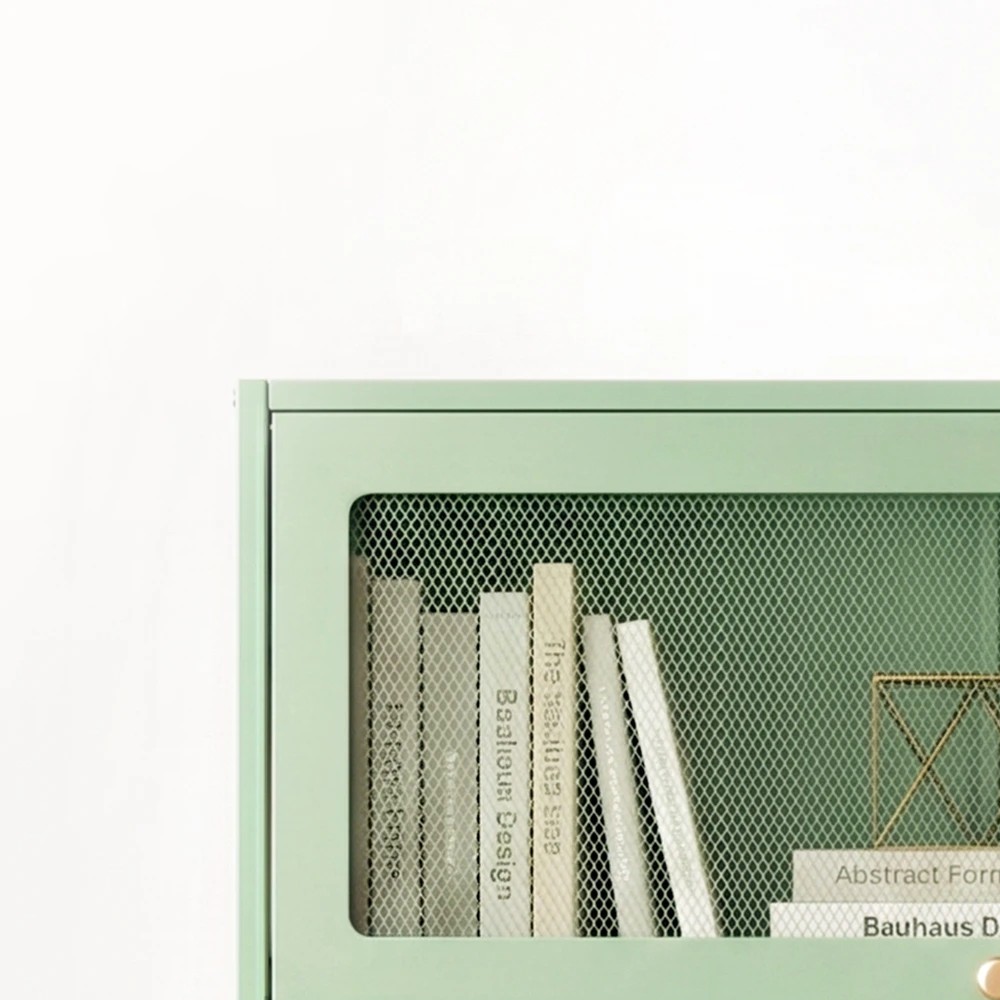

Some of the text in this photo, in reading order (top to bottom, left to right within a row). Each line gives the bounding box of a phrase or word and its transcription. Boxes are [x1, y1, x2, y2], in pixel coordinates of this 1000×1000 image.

[490, 811, 518, 901] Design
[835, 865, 940, 884] Abstract
[864, 916, 974, 937] Bauhaus
